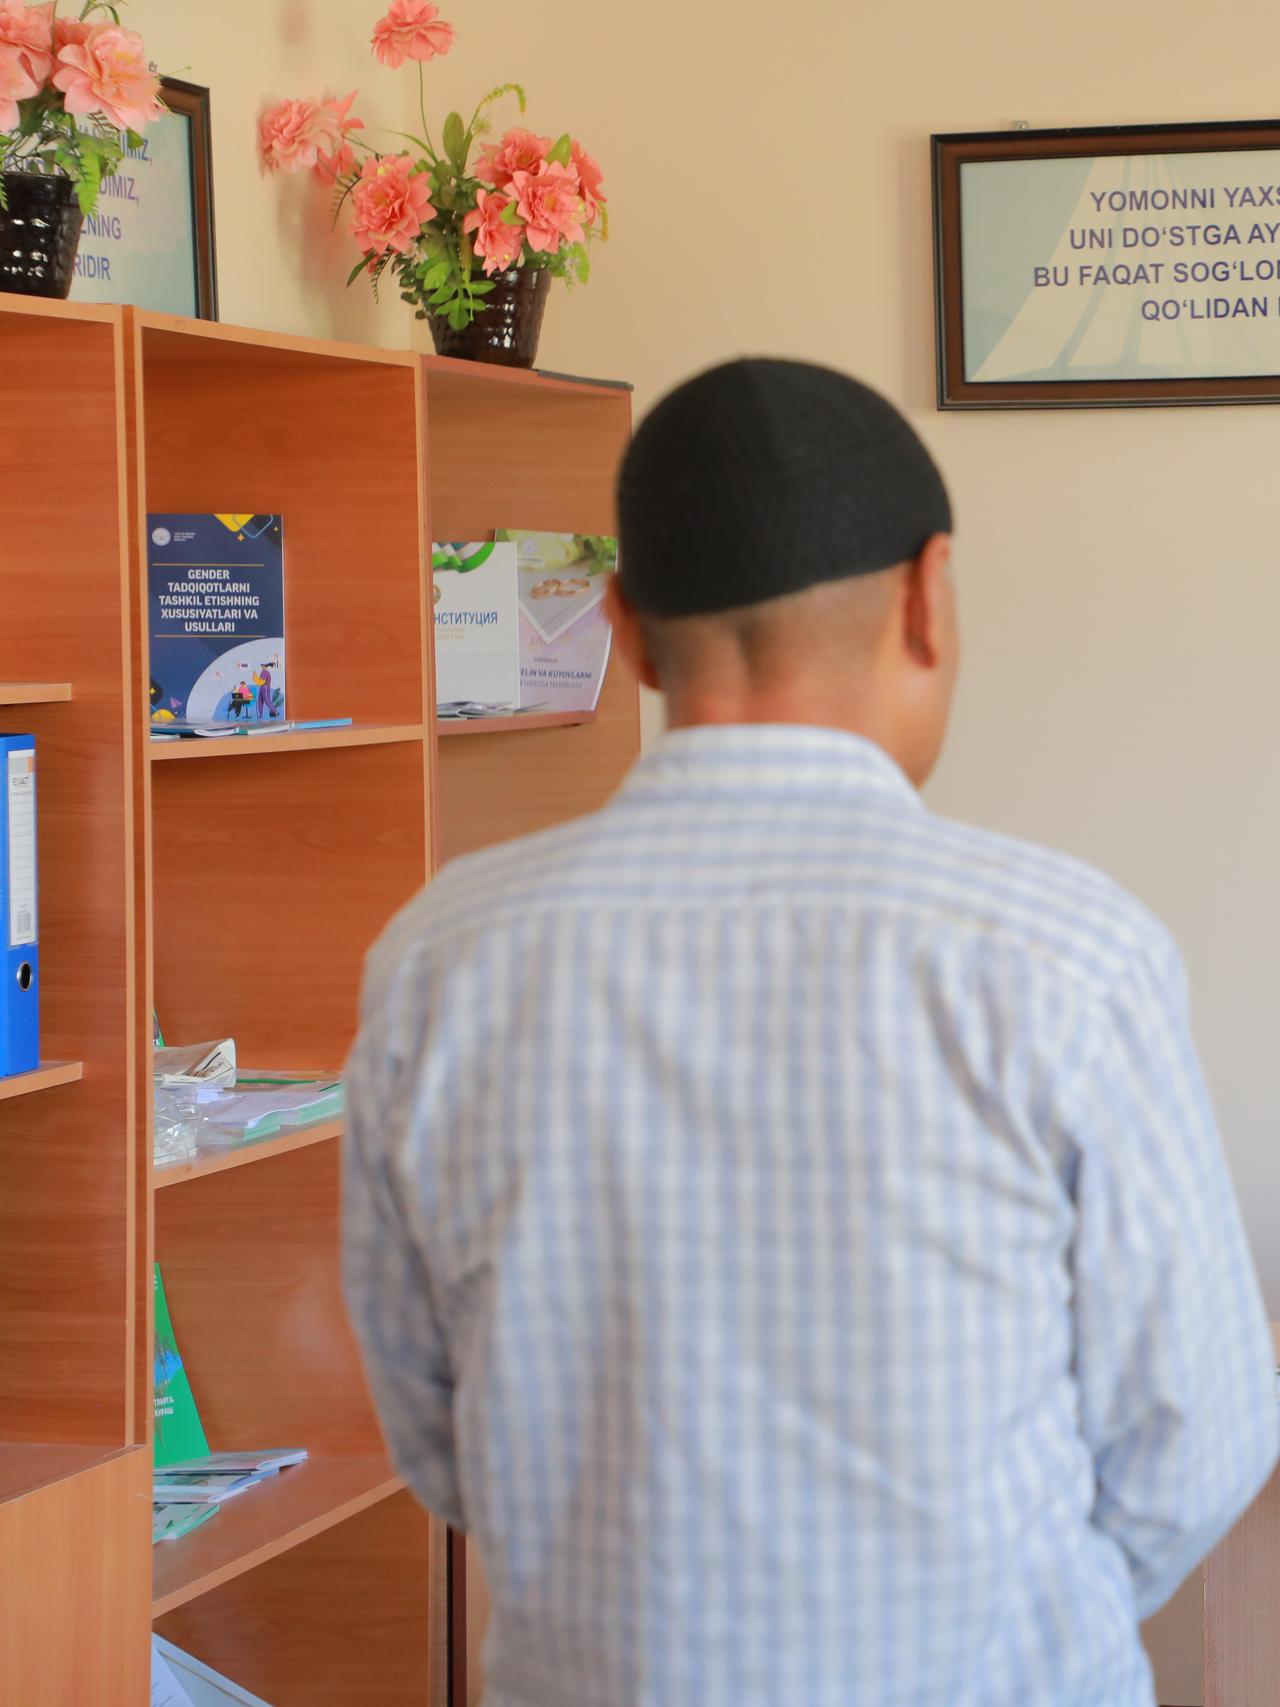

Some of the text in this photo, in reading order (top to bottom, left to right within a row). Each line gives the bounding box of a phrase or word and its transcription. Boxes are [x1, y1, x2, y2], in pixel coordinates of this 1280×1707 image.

[1091, 187, 1215, 213] YOMONNI
[1070, 227, 1112, 250] UNI
[1034, 265, 1069, 288] BU
[1079, 262, 1165, 290] FAQAT
[188, 569, 230, 580] GENDER
[168, 582, 250, 594] TADQIQOTLARNI
[159, 595, 260, 606] TASHKIL ETISHNING
[161, 608, 258, 619] XUSUSIYATLARI VA
[434, 611, 498, 627] НСТИТУЦИЯ
[185, 621, 235, 632] USULLARI
